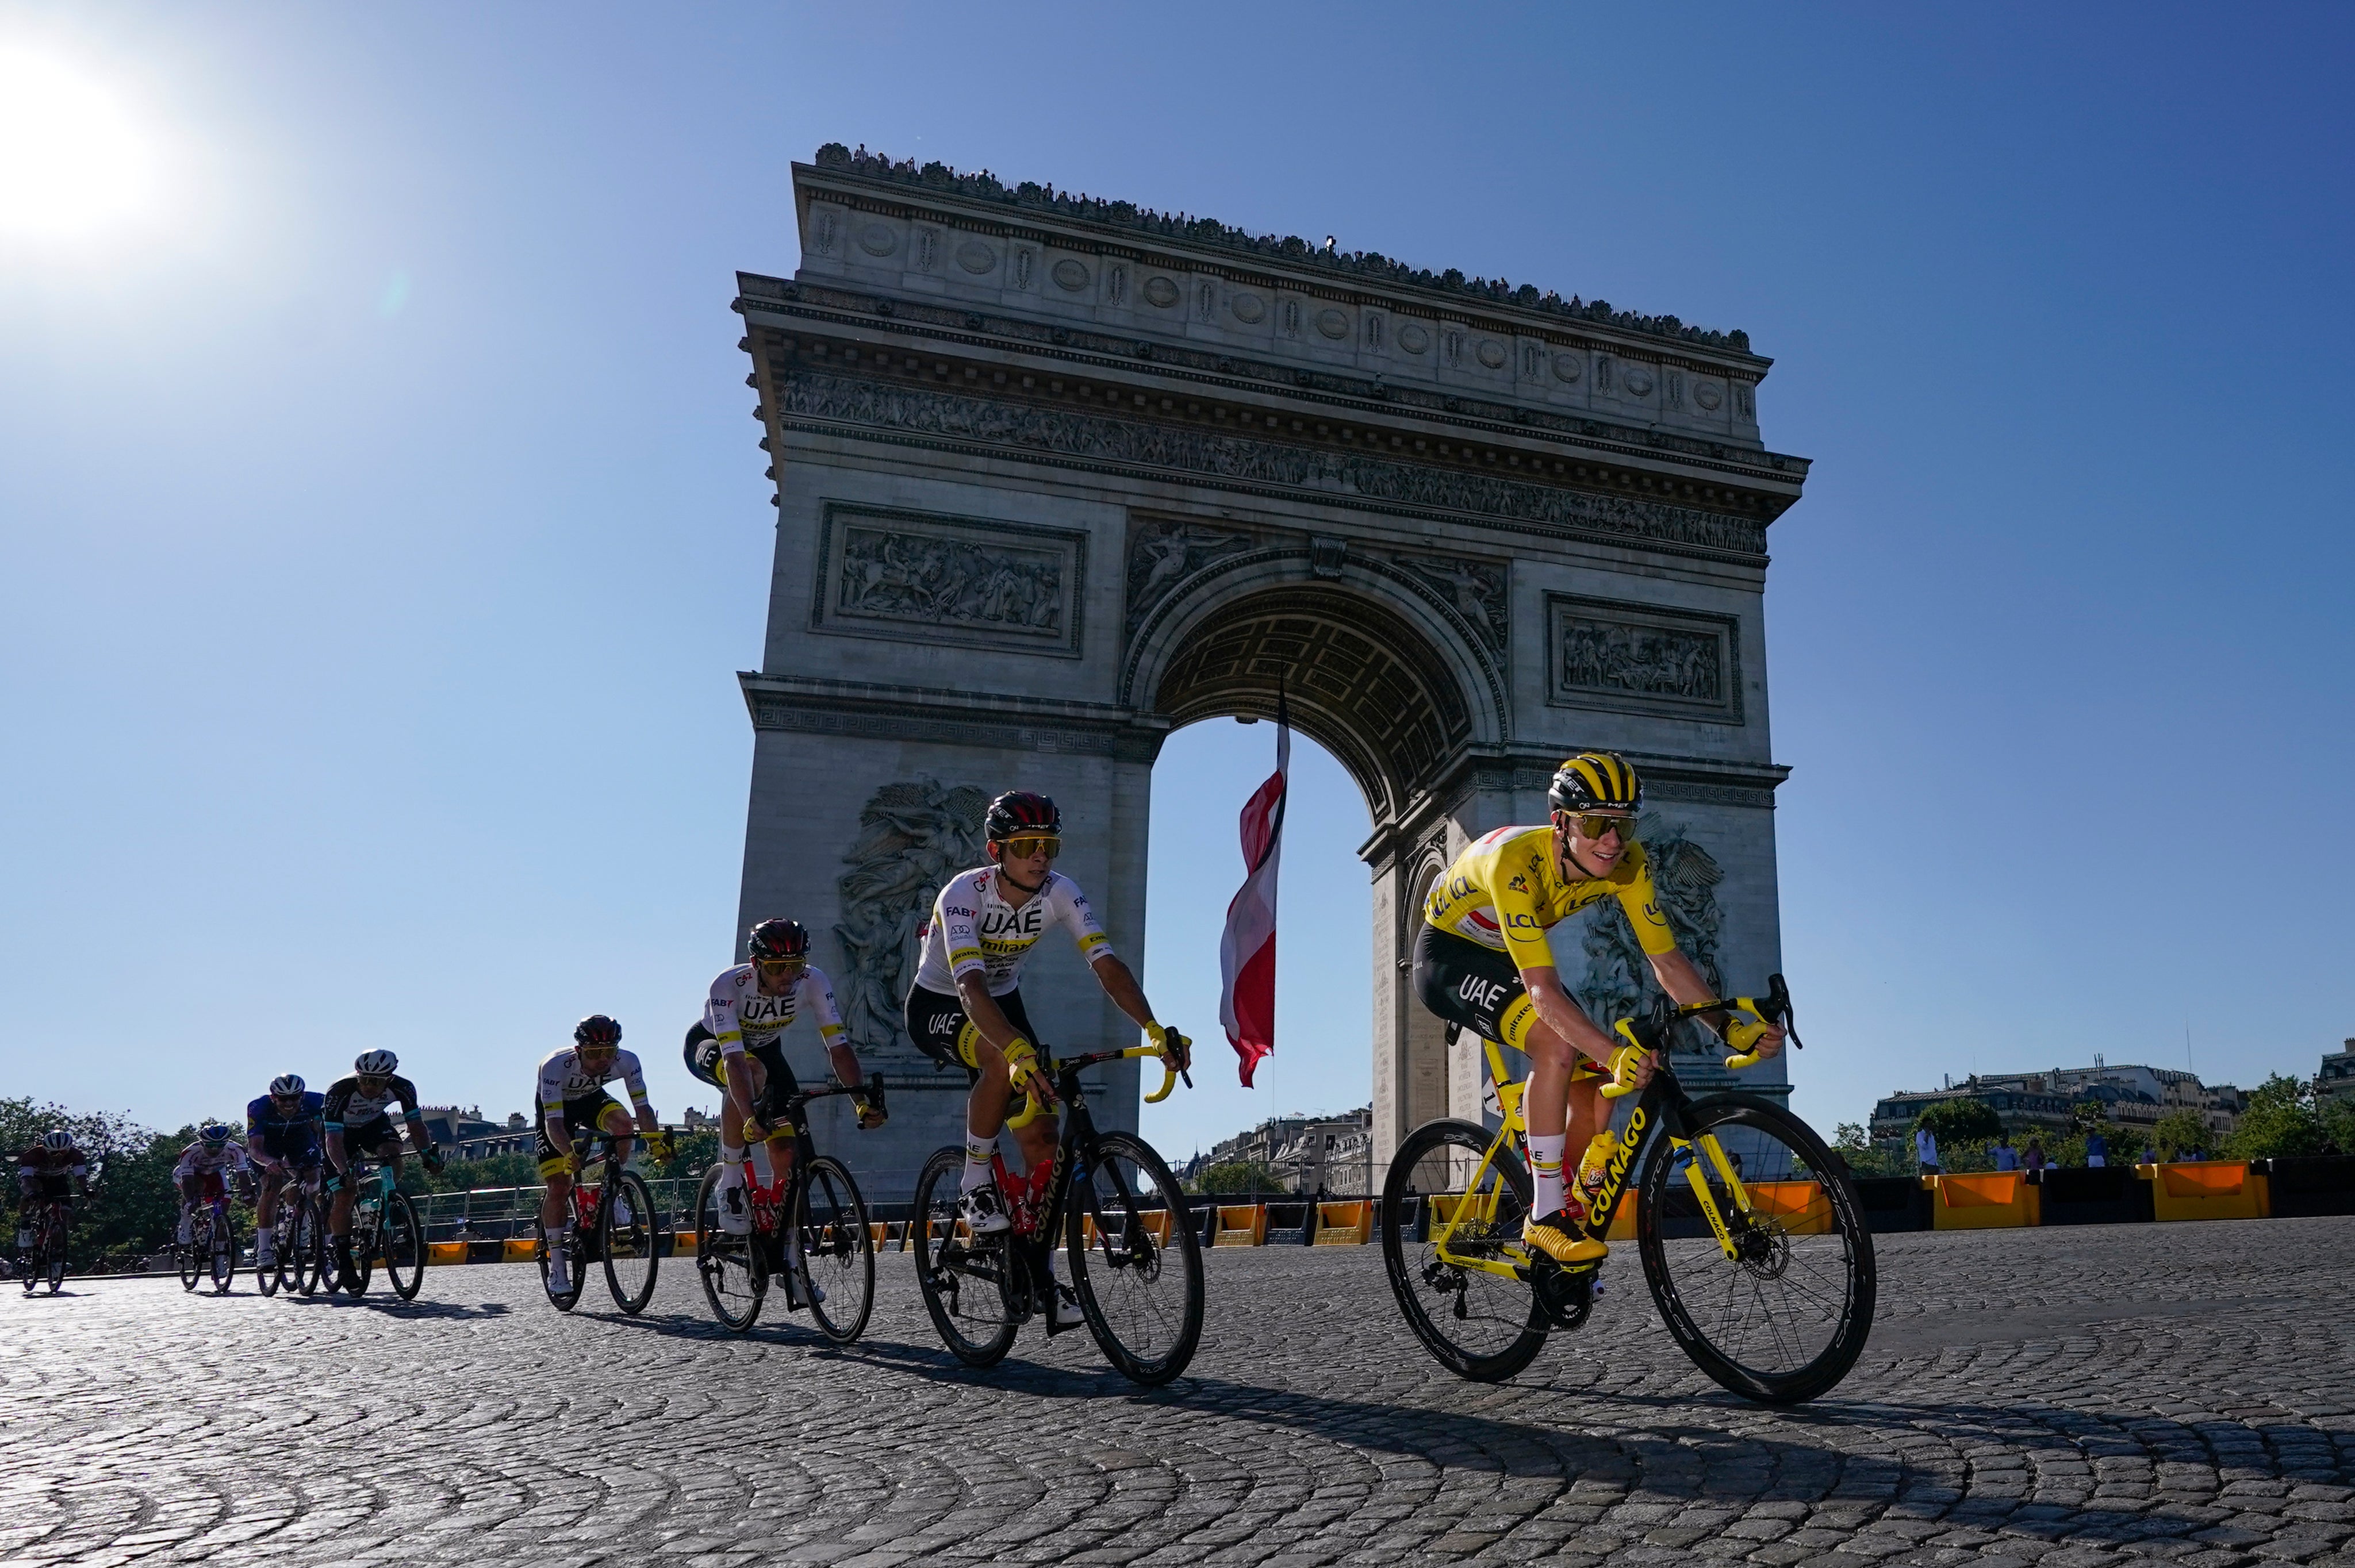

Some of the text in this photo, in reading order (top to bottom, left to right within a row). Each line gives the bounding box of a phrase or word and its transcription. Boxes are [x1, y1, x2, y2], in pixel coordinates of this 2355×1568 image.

[973, 871, 991, 893] G42
[1449, 876, 1478, 900] LCL
[1073, 895, 1088, 908] FA
[981, 909, 1042, 934] UAE
[1506, 913, 1542, 929] LCL
[735, 973, 753, 987] G42
[1459, 974, 1508, 1012] UAE
[744, 997, 796, 1020] UAE
[929, 1013, 962, 1035] UAE
[1509, 1002, 1534, 1043] Emirates
[695, 1046, 717, 1068] UAE
[1444, 1133, 1482, 1151] BORA
[1590, 1106, 1646, 1227] COLNAGO
[1033, 1144, 1065, 1243] COLNAGO
[1702, 1200, 1725, 1242] COLNAGO
